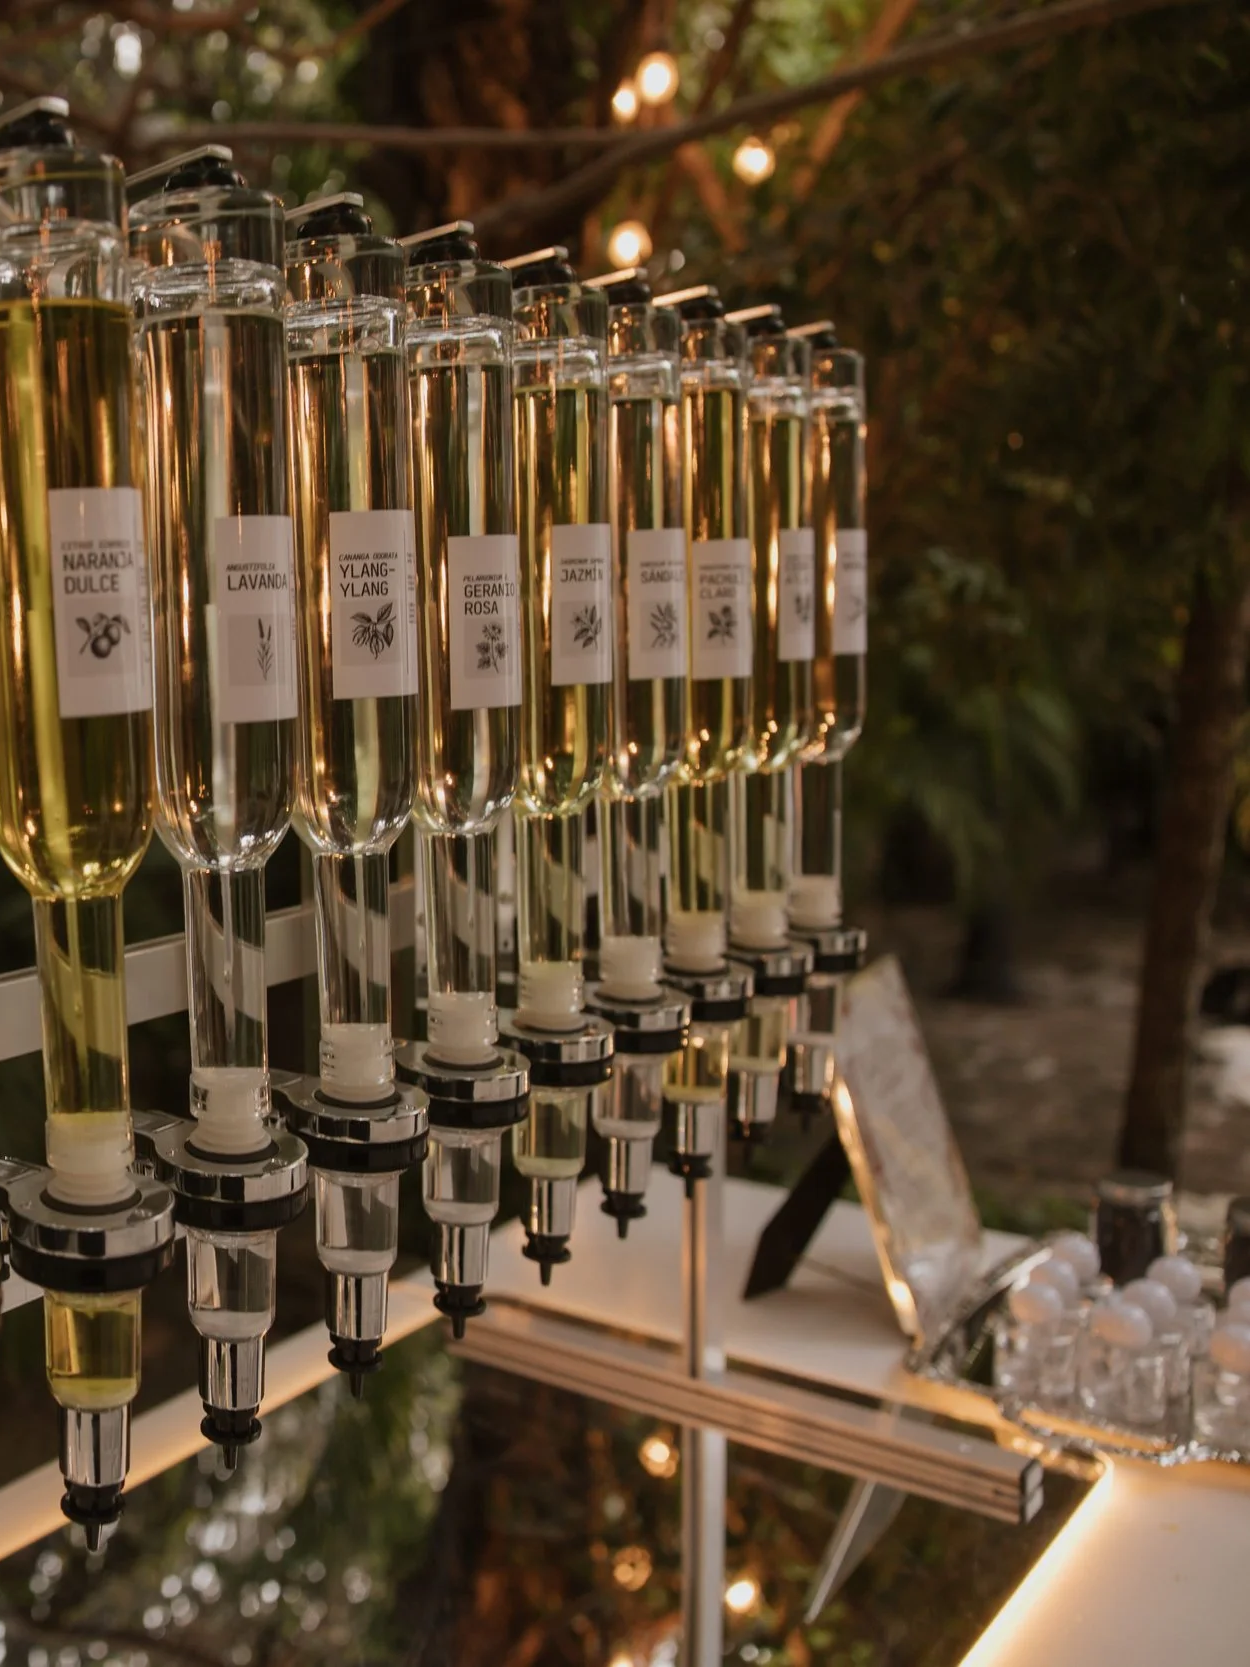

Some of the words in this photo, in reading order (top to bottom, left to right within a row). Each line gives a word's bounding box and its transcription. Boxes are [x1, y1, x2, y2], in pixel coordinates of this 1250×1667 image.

[62, 550, 135, 571] NARANJA
[340, 562, 396, 579] YLANG-
[64, 573, 120, 595] DULCE
[227, 572, 288, 591] LAVANDA
[340, 581, 389, 598] YLANG
[464, 583, 515, 599] GERANIO
[464, 601, 499, 616] ROSA
